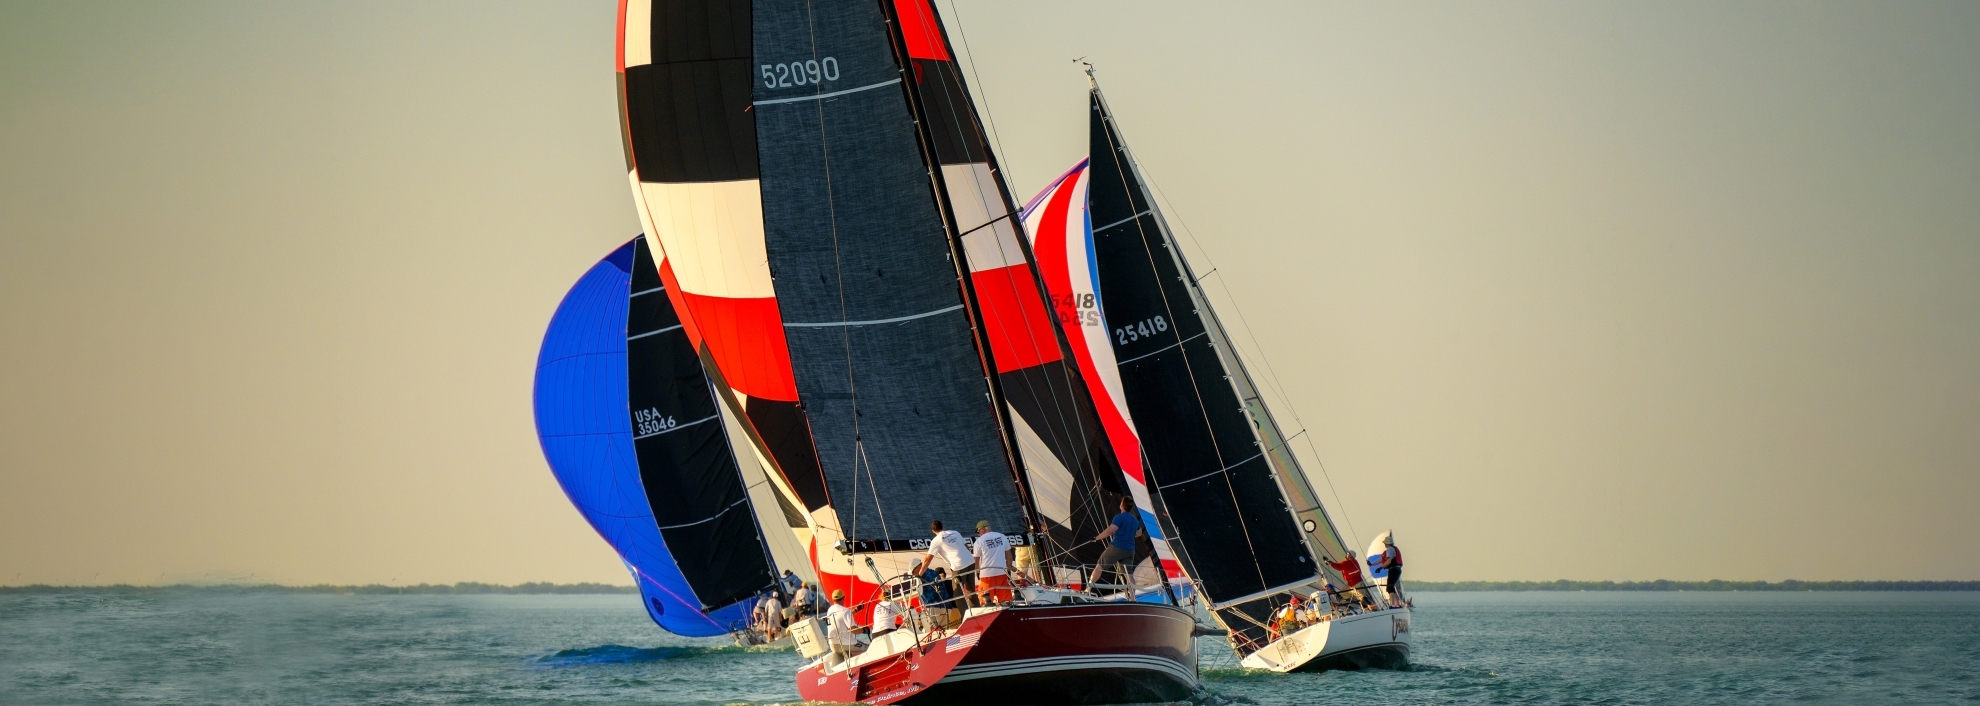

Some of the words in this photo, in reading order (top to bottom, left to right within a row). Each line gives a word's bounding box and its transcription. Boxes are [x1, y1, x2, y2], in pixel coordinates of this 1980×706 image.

[761, 57, 839, 89] 52090
[1116, 315, 1168, 345] 25418
[635, 407, 661, 422] USA
[638, 415, 676, 435] 35046
